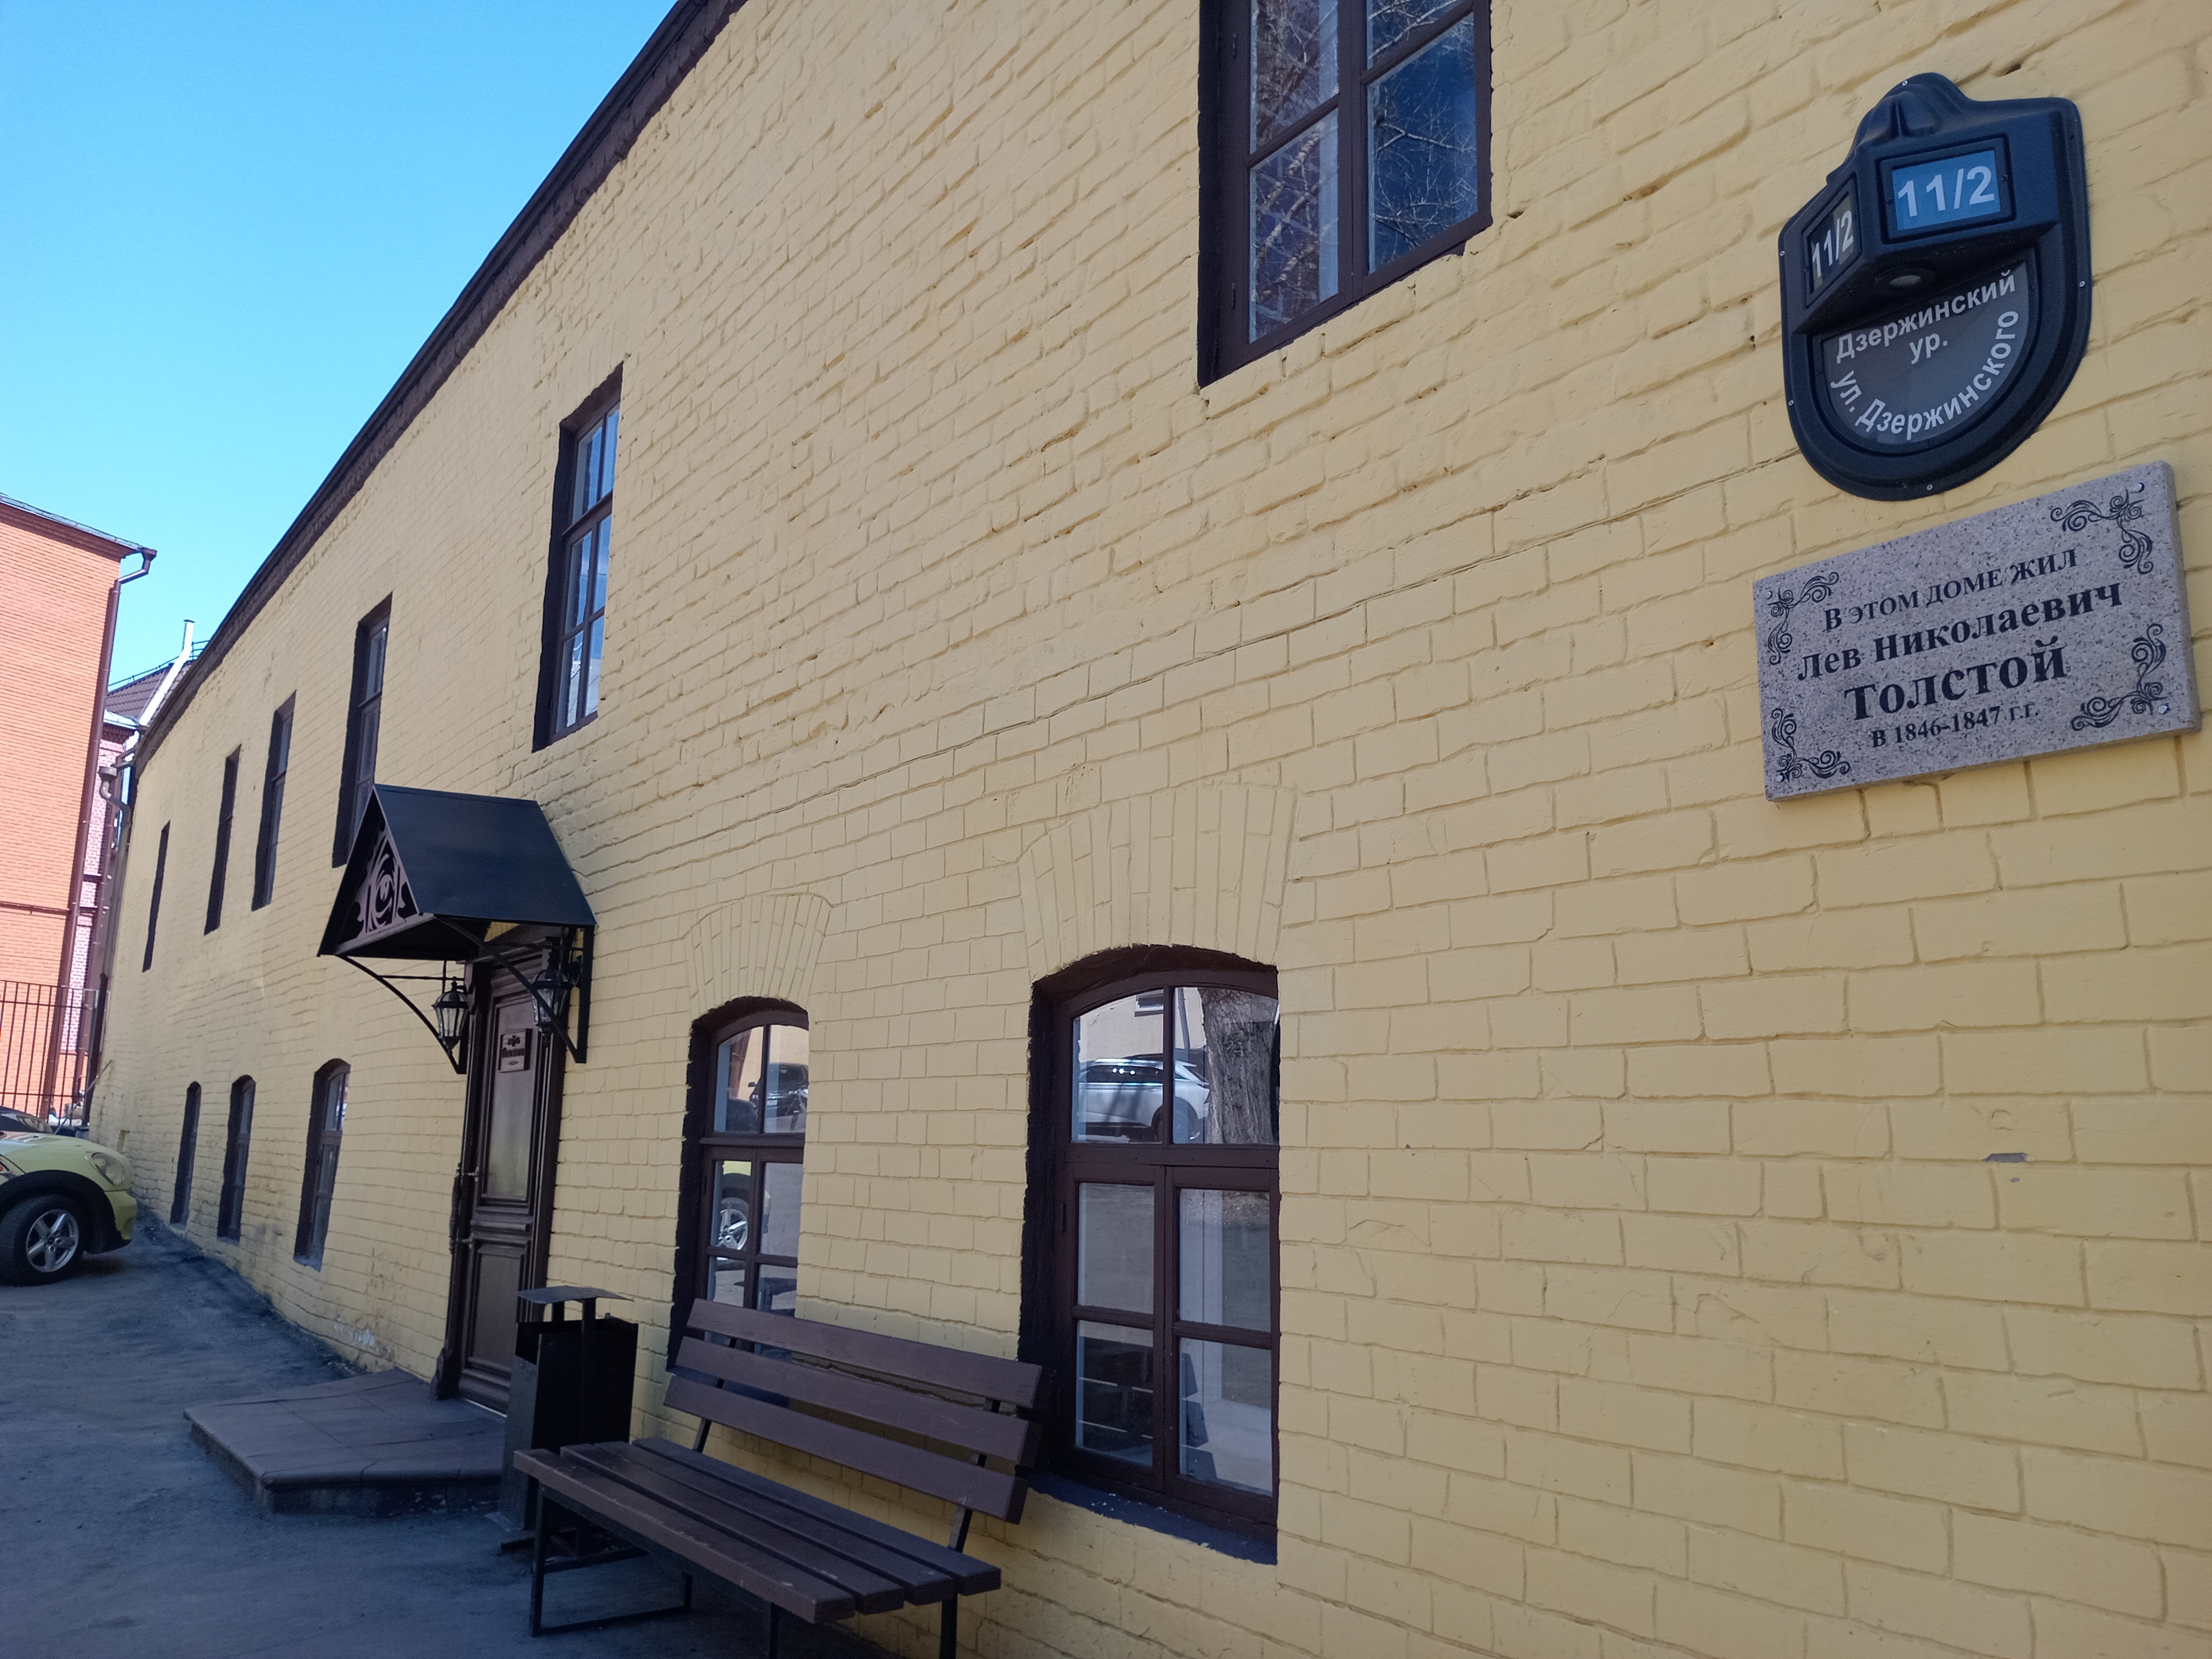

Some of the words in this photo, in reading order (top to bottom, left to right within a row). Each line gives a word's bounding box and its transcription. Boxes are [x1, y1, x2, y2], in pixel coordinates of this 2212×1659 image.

[1898, 166, 1994, 217] 11/2
[1812, 210, 1854, 279] 11/2
[1837, 269, 2015, 364] Дзержинский
[1909, 333, 1948, 365] ур.
[1830, 370, 1862, 413] ул.
[1854, 311, 2019, 441] Дзержинского
[1798, 648, 1862, 680] Лев
[1873, 583, 2123, 663] Николаевич
[1823, 608, 1842, 632] В
[1849, 591, 1919, 624] ЭТОМ
[1926, 569, 2003, 608] ДОМЕ
[2009, 549, 2078, 585] ЖИЛ
[1844, 635, 2067, 720] ТОЛСТОЙ
[1894, 706, 2000, 744] 1846-1847
